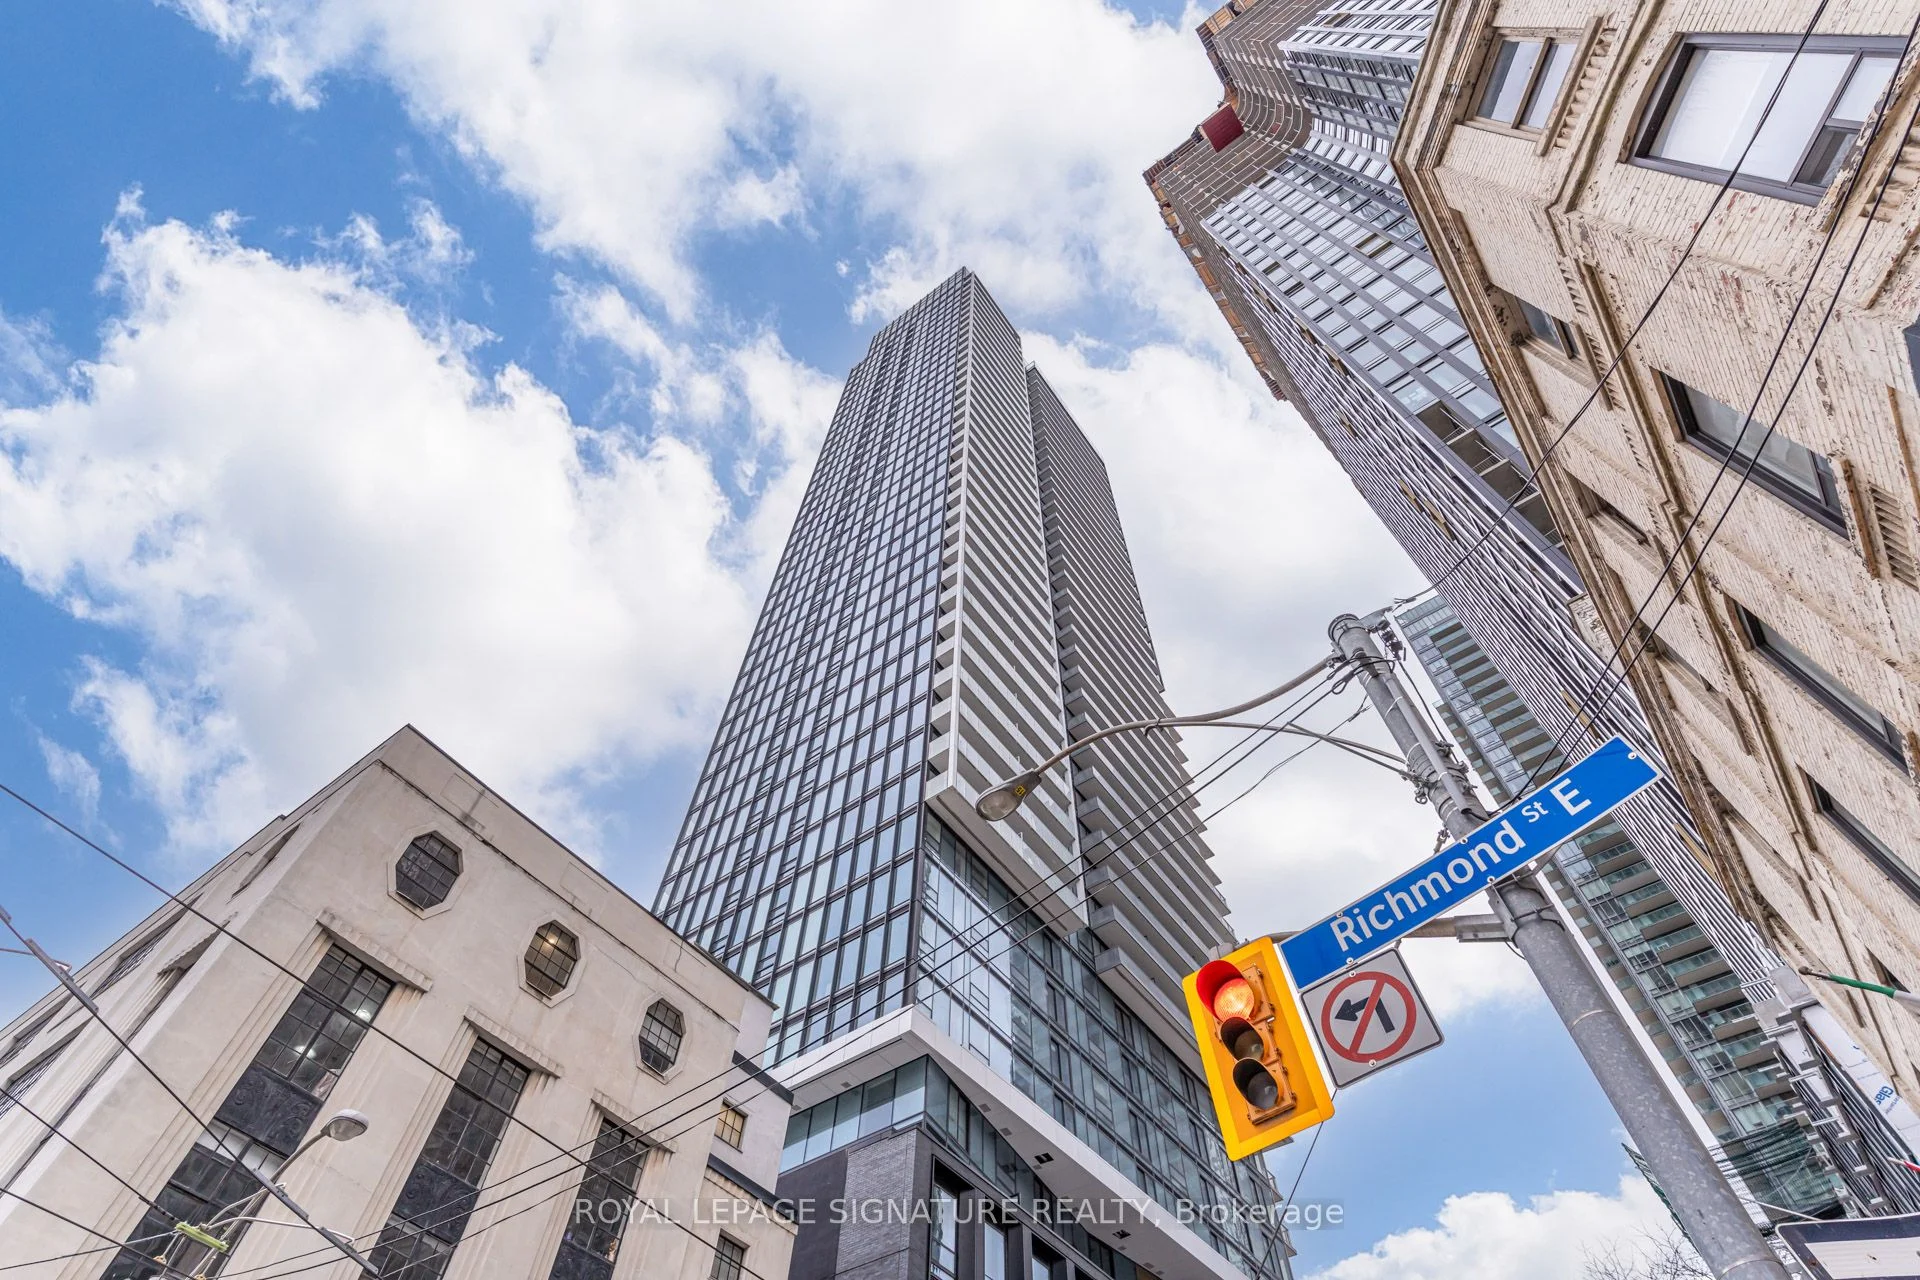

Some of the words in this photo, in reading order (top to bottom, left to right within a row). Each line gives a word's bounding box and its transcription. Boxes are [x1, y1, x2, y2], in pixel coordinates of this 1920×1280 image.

[1330, 818, 1527, 953] Richmond
[1521, 800, 1549, 823] St
[1549, 777, 1592, 817] E
